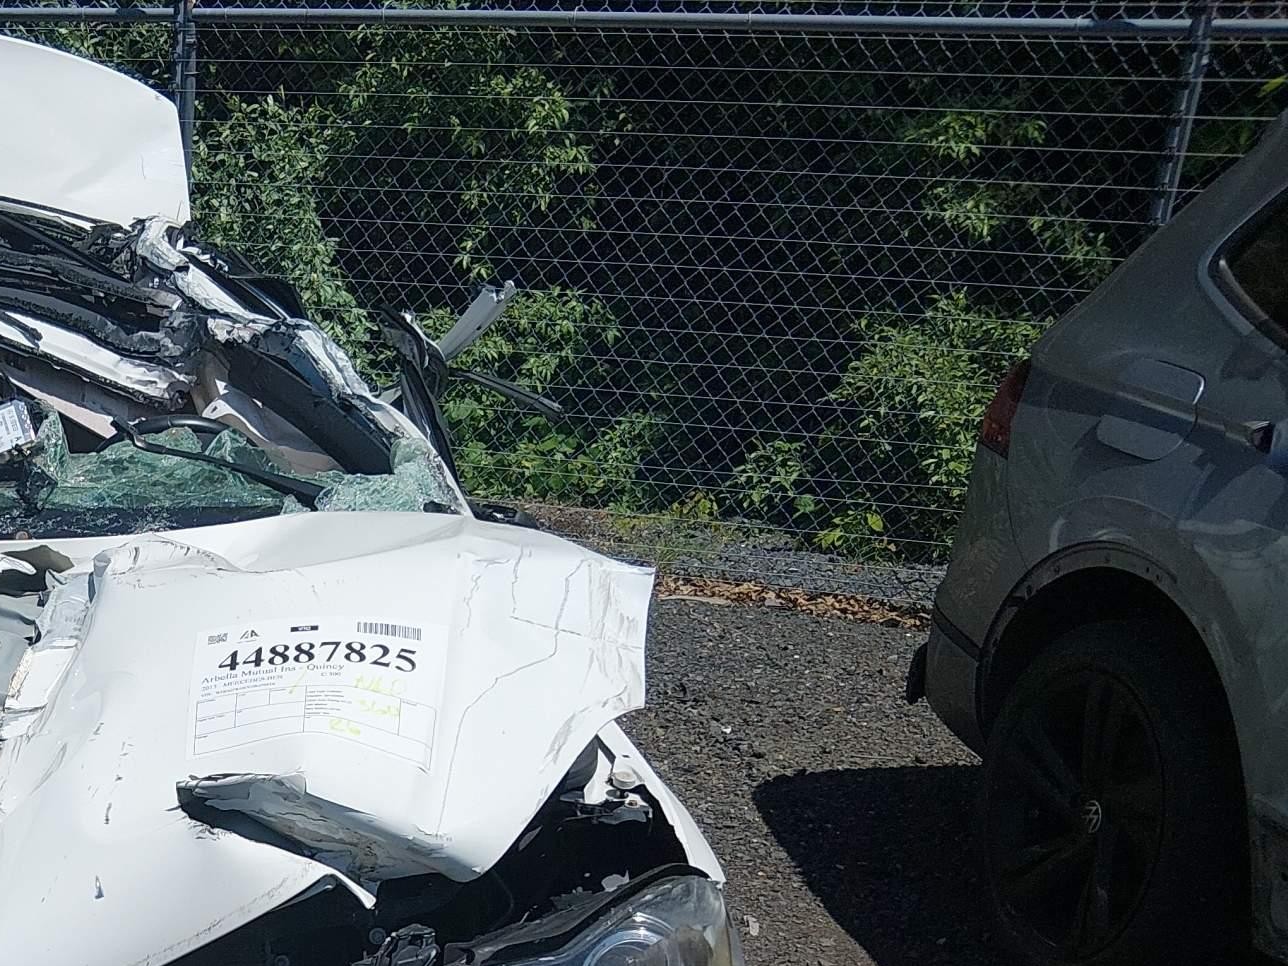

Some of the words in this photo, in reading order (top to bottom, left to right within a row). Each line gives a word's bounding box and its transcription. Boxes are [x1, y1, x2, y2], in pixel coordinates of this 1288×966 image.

[218, 641, 417, 672] 44887825
[201, 672, 238, 684] Arbella
[241, 666, 277, 677] Mutual
[306, 662, 345, 671] Quincy
